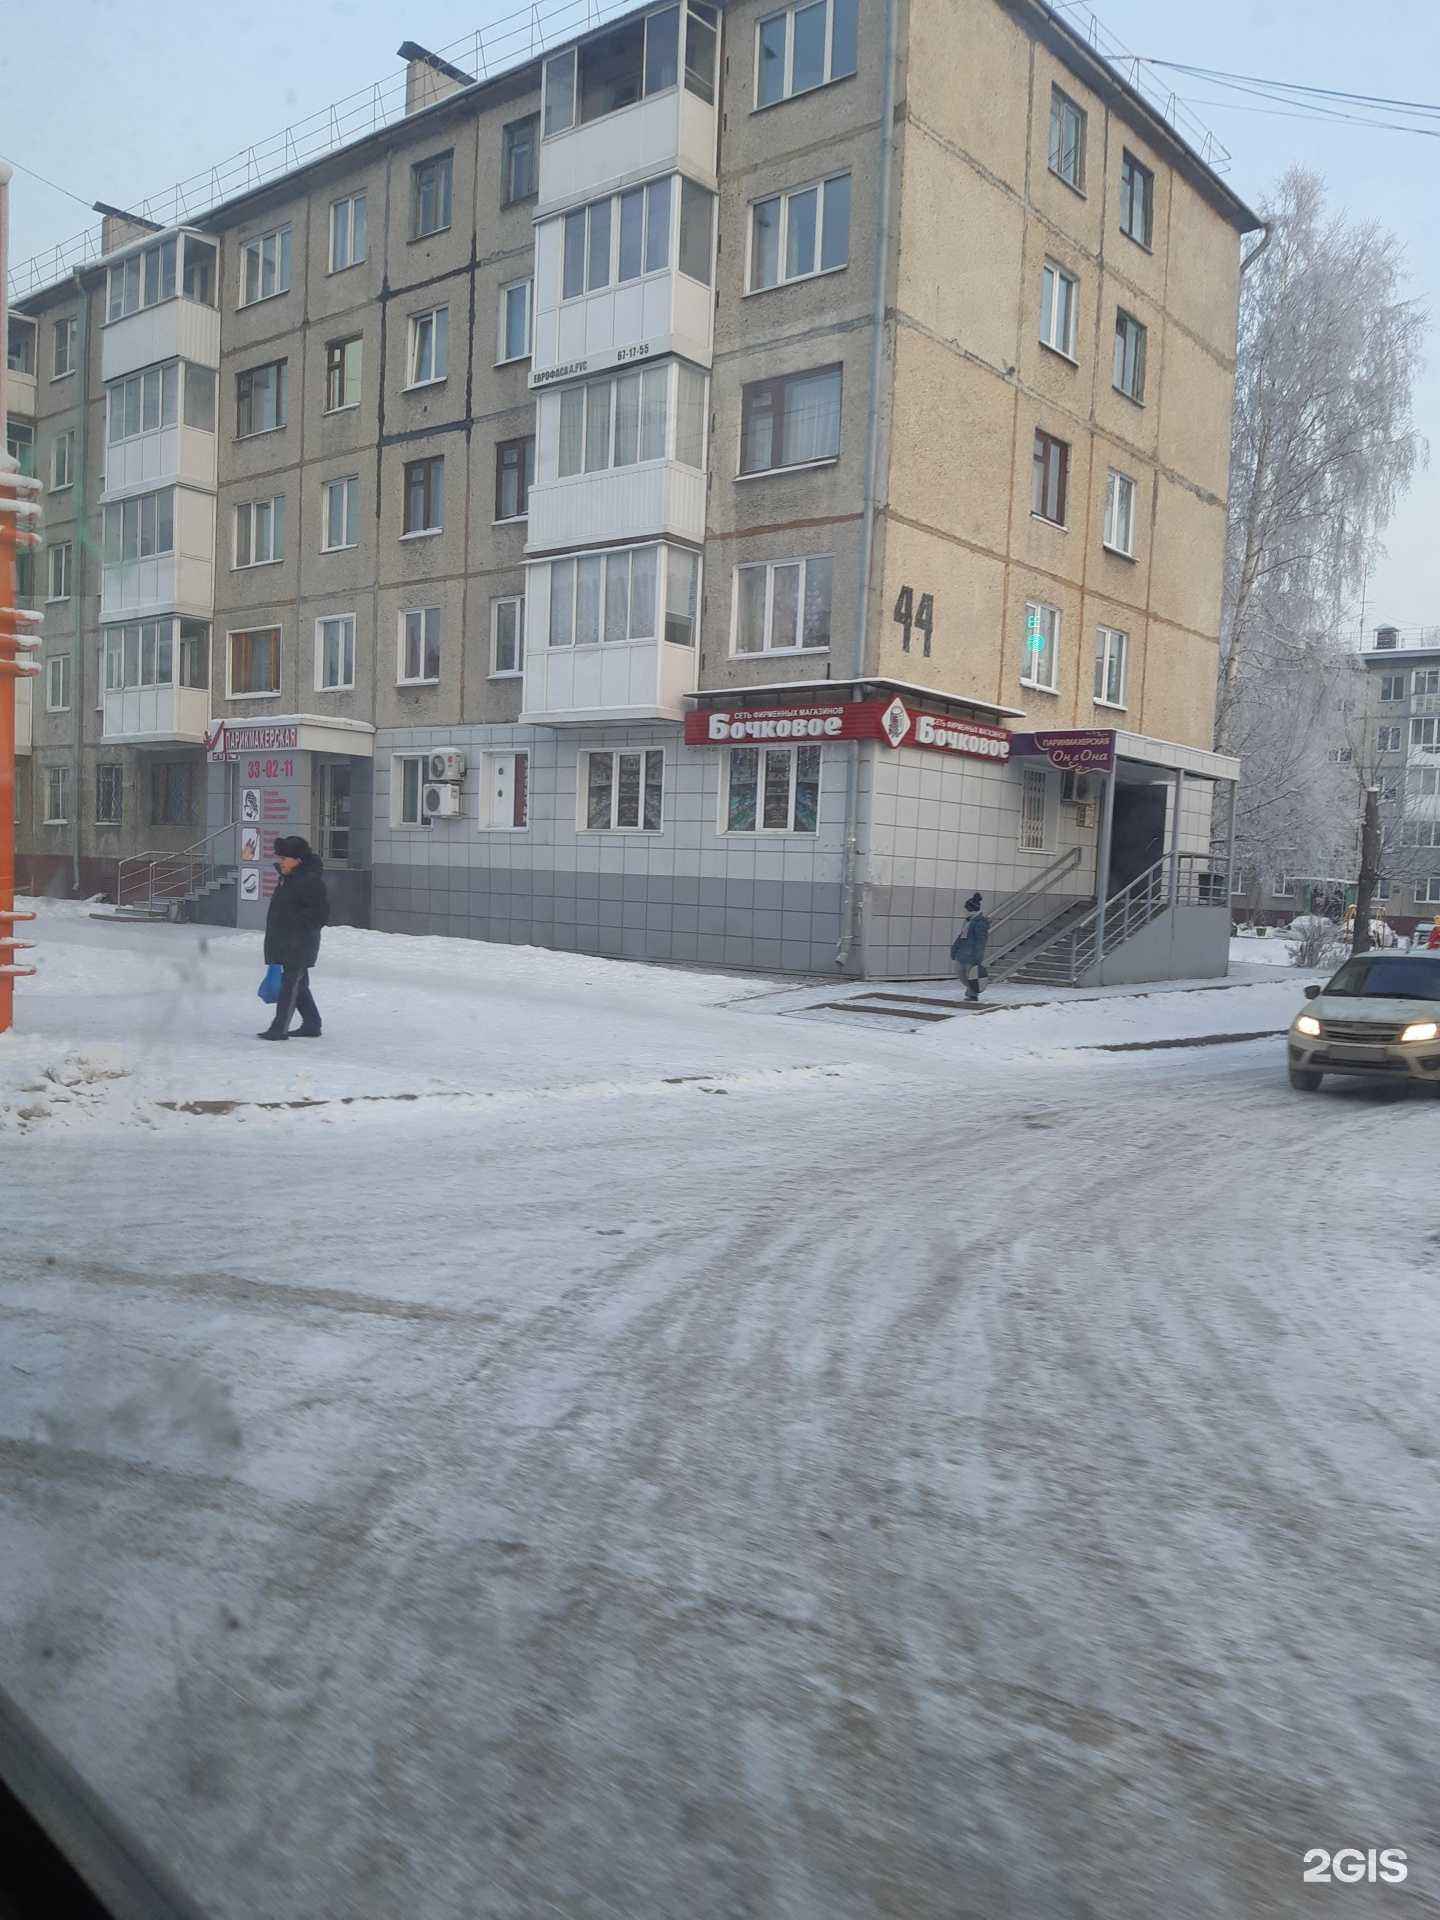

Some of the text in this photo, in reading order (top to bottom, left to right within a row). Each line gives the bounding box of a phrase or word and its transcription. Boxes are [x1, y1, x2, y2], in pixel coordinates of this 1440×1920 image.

[893, 585, 934, 658] 44
[734, 706, 844, 720] СЕТЬ ФИРМЕННЫХ МАГАЗИНОВ
[225, 728, 298, 749] ПАРИКМАХЕРСКАЯ
[708, 713, 843, 740] Бочковое
[915, 715, 1010, 759] Бочковое
[1052, 750, 1071, 762] Он
[1080, 749, 1108, 761] Она
